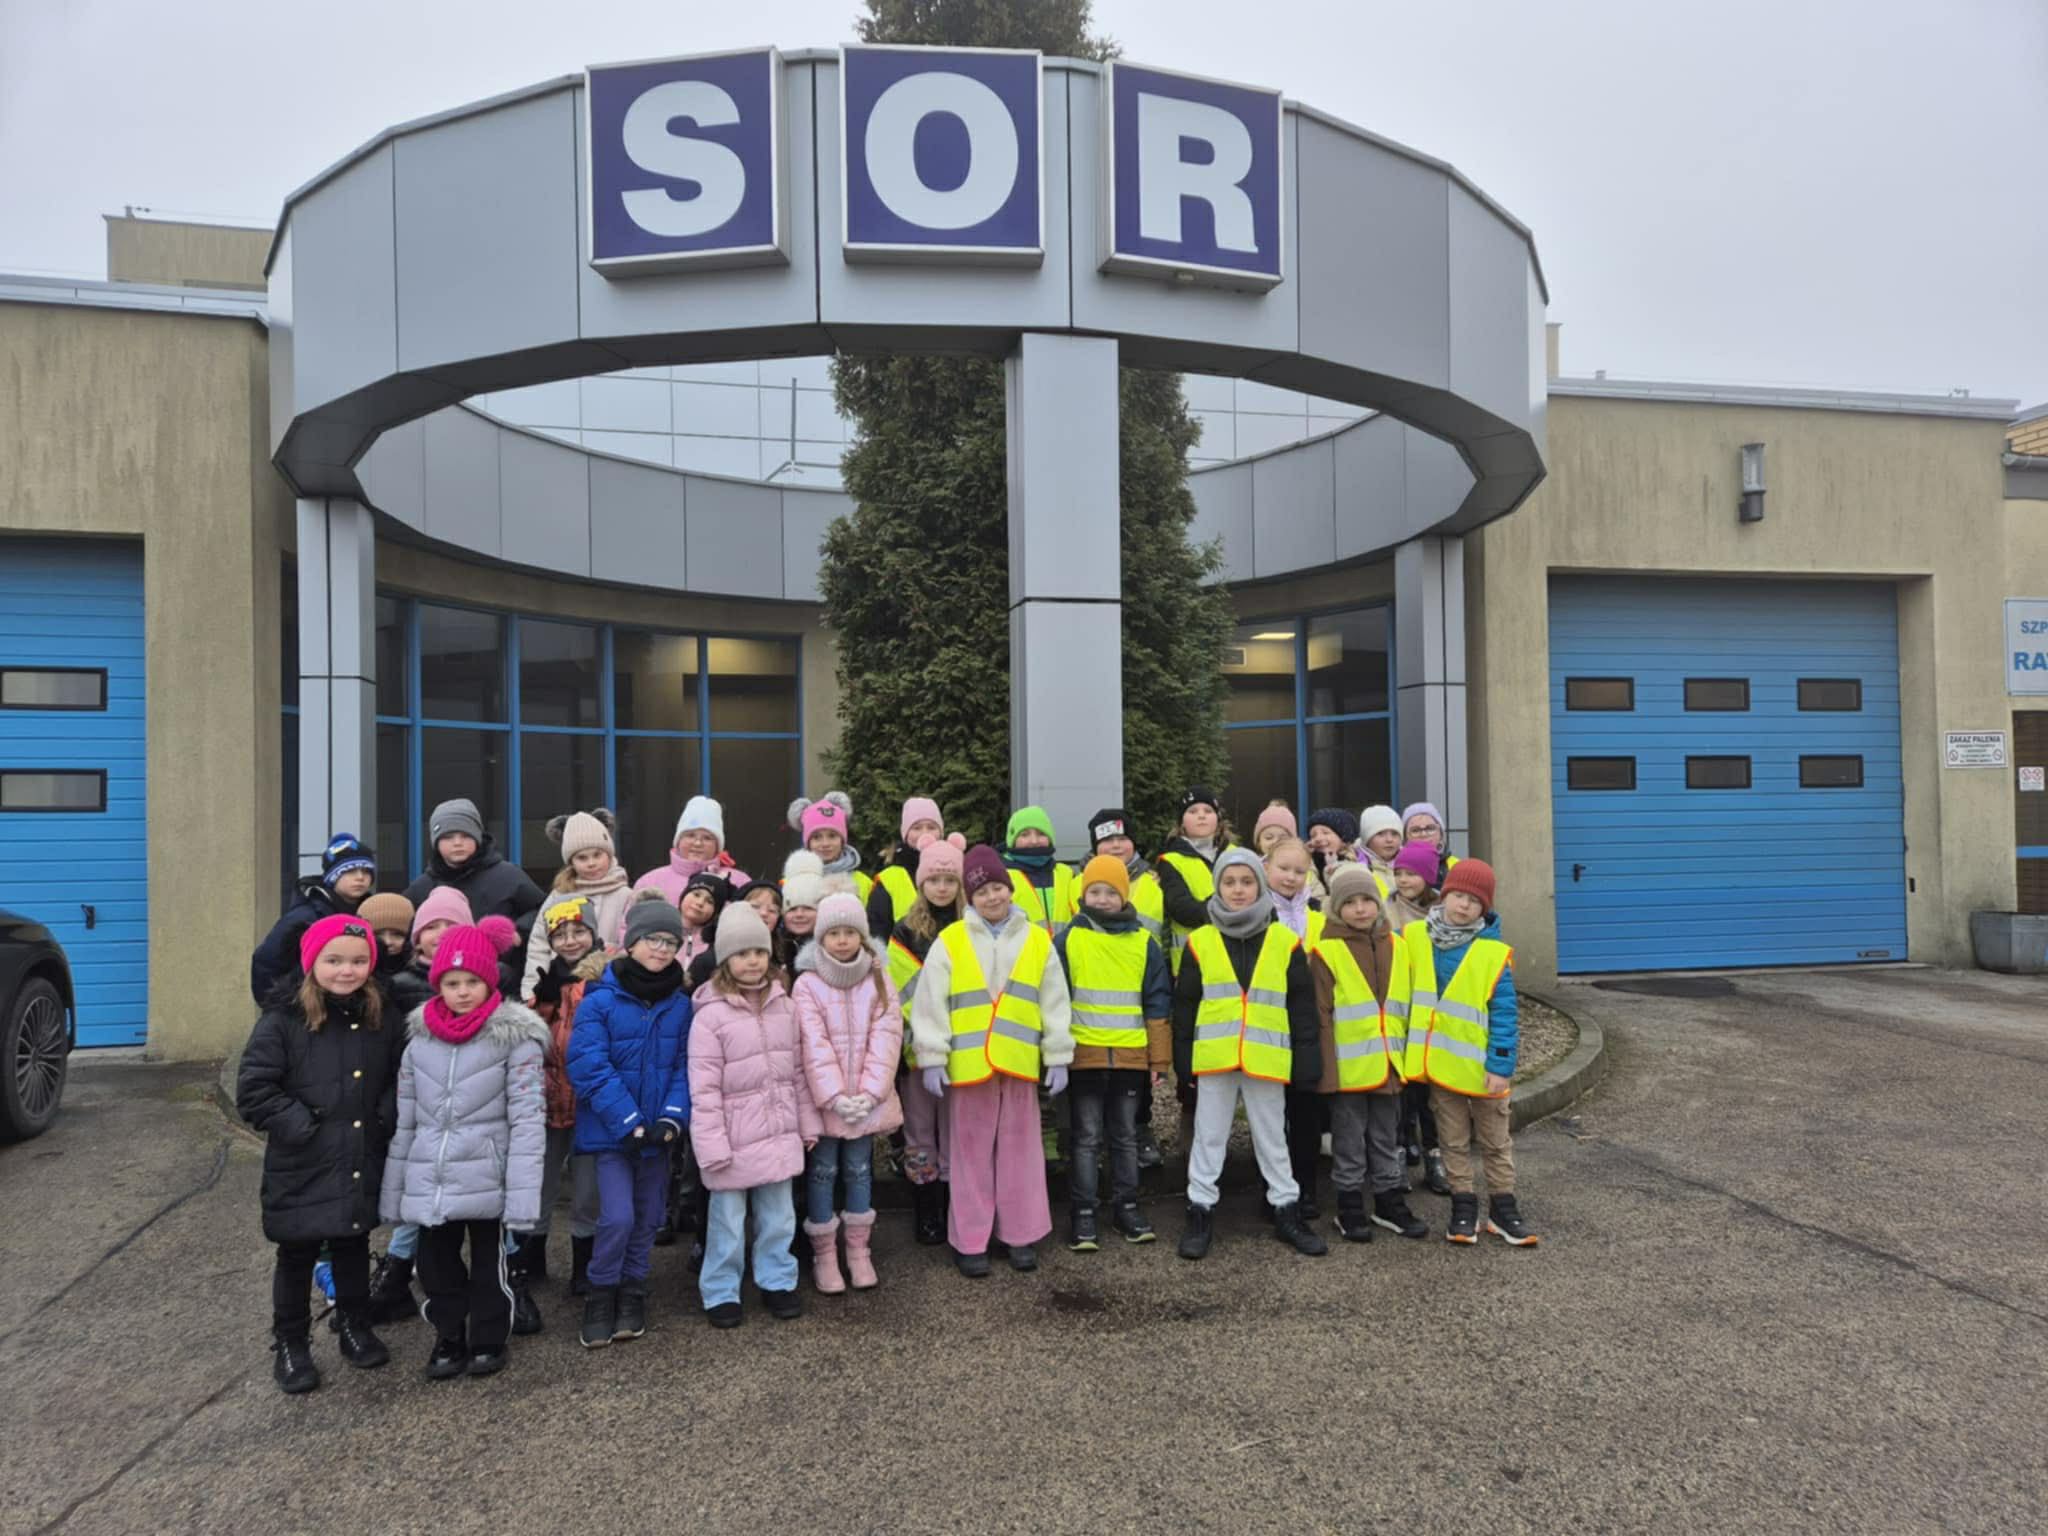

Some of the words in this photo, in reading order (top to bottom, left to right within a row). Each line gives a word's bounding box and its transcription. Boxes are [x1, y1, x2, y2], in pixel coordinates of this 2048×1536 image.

[621, 71, 1259, 254] SOR
[2014, 652, 2048, 671] RA
[1950, 735, 1972, 744] ZAKAZ
[1972, 735, 2001, 743] PALENIA
